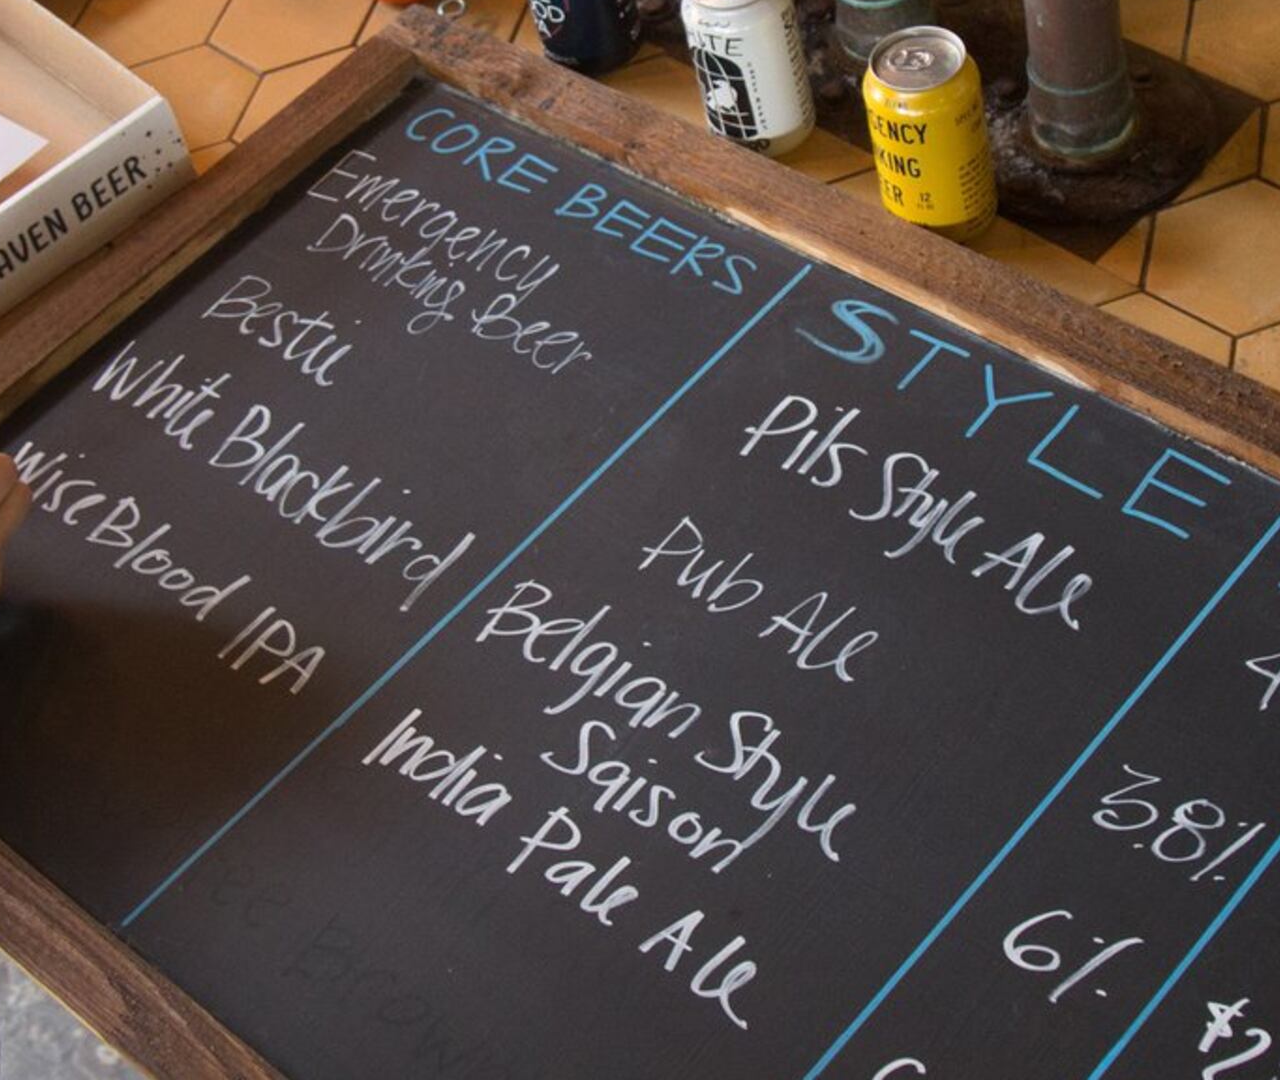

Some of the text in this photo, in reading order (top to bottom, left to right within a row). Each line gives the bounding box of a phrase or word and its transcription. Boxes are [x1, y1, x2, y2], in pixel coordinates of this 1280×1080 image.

[71, 155, 148, 222] BEER
[306, 148, 561, 302] Emergency
[405, 107, 757, 296] CORE BEERS
[306, 214, 592, 375] Drinking Beer
[91, 340, 476, 613] White Blackbird
[739, 395, 1094, 632] Pils Style Ale
[795, 299, 1232, 540] STYLE
[13, 440, 326, 695] Wise Blood IPA
[637, 516, 880, 683] Pub Ale
[475, 579, 857, 863] Belgian Style
[539, 720, 745, 874] Saison
[361, 708, 513, 827] India
[505, 806, 639, 926] Pale
[638, 910, 758, 1030] Ale
[1001, 909, 1145, 1003] 6%
